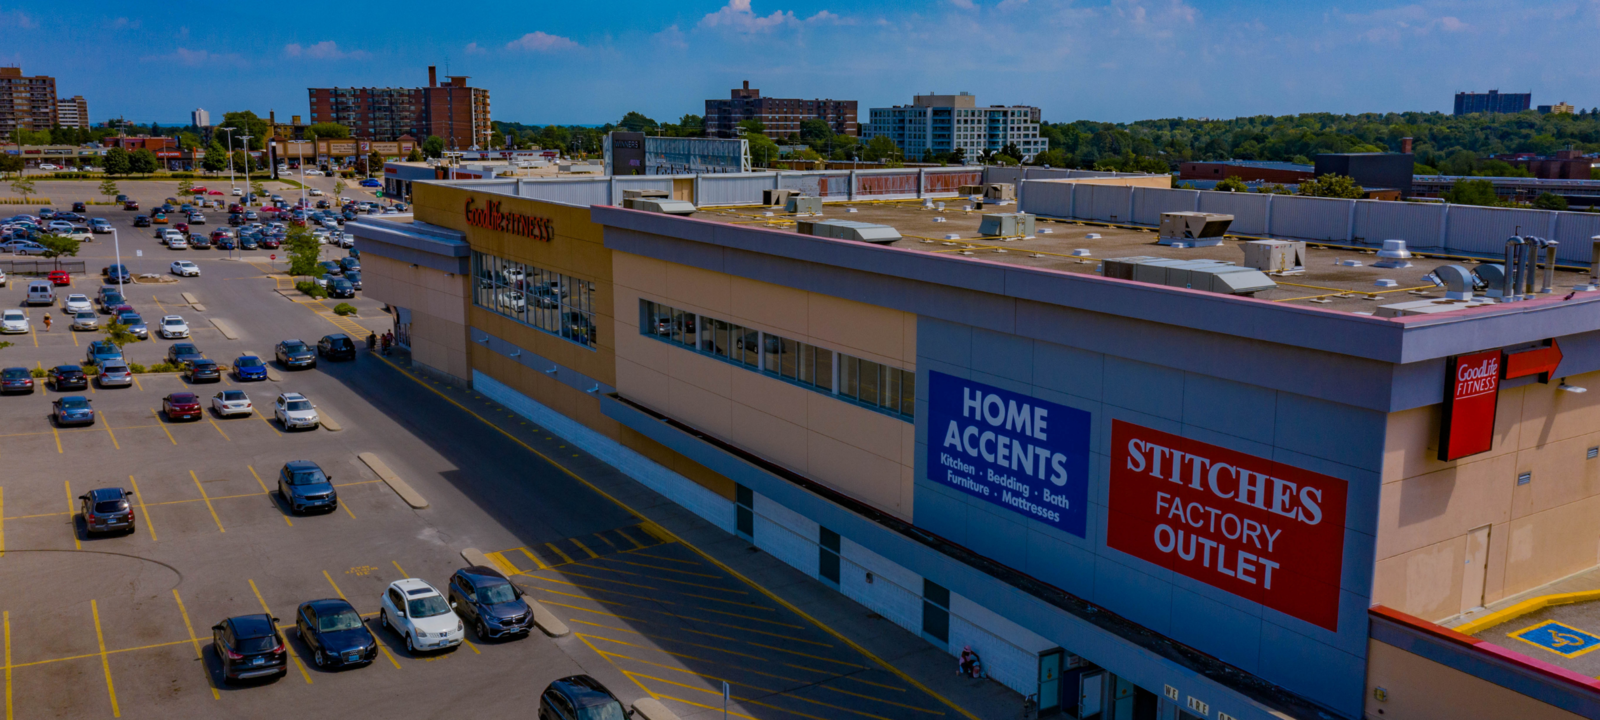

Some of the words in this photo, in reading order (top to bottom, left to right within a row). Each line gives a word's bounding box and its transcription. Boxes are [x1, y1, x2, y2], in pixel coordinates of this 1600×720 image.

[464, 198, 503, 231] GoodLife
[505, 212, 549, 242] FITNESS
[1457, 376, 1496, 396] FITNESS
[1458, 358, 1498, 381] GoodLife
[963, 386, 1048, 441] HOME
[940, 452, 975, 476] Kitchen
[987, 468, 1030, 497] Bedding
[1043, 488, 1069, 509] Bath
[943, 419, 1068, 487] ACCENTS
[947, 469, 990, 496] Furniture
[1002, 489, 1060, 522] Mattresses
[1127, 438, 1323, 525] STITCHES
[1156, 491, 1282, 553] FACTORY
[1154, 523, 1280, 590] OUTLET
[1165, 685, 1177, 700] WE
[1188, 697, 1207, 715] ARE
